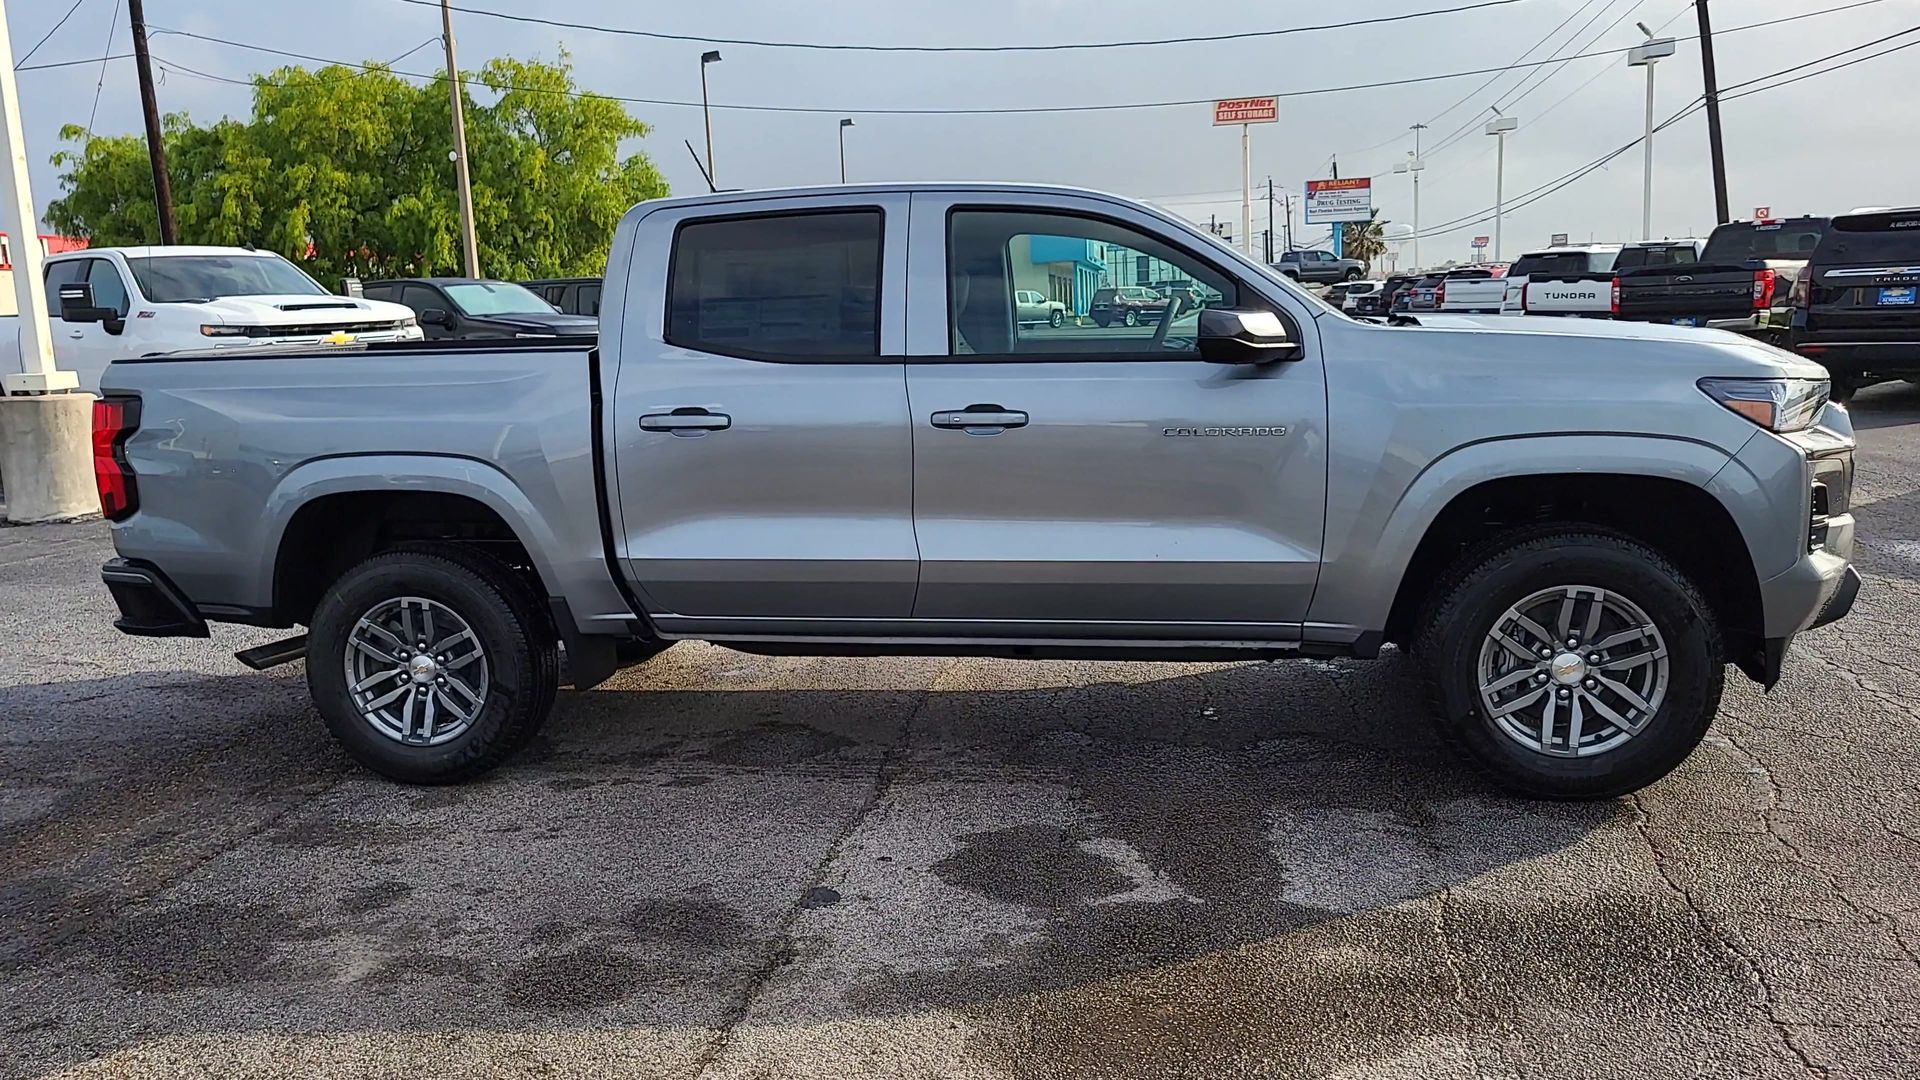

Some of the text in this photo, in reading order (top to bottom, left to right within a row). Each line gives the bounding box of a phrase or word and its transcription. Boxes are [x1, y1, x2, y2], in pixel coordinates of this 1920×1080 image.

[1218, 109, 1274, 120] SELF STORAGE
[1328, 179, 1360, 187] RELIANT
[1162, 426, 1287, 437] COLORADO
